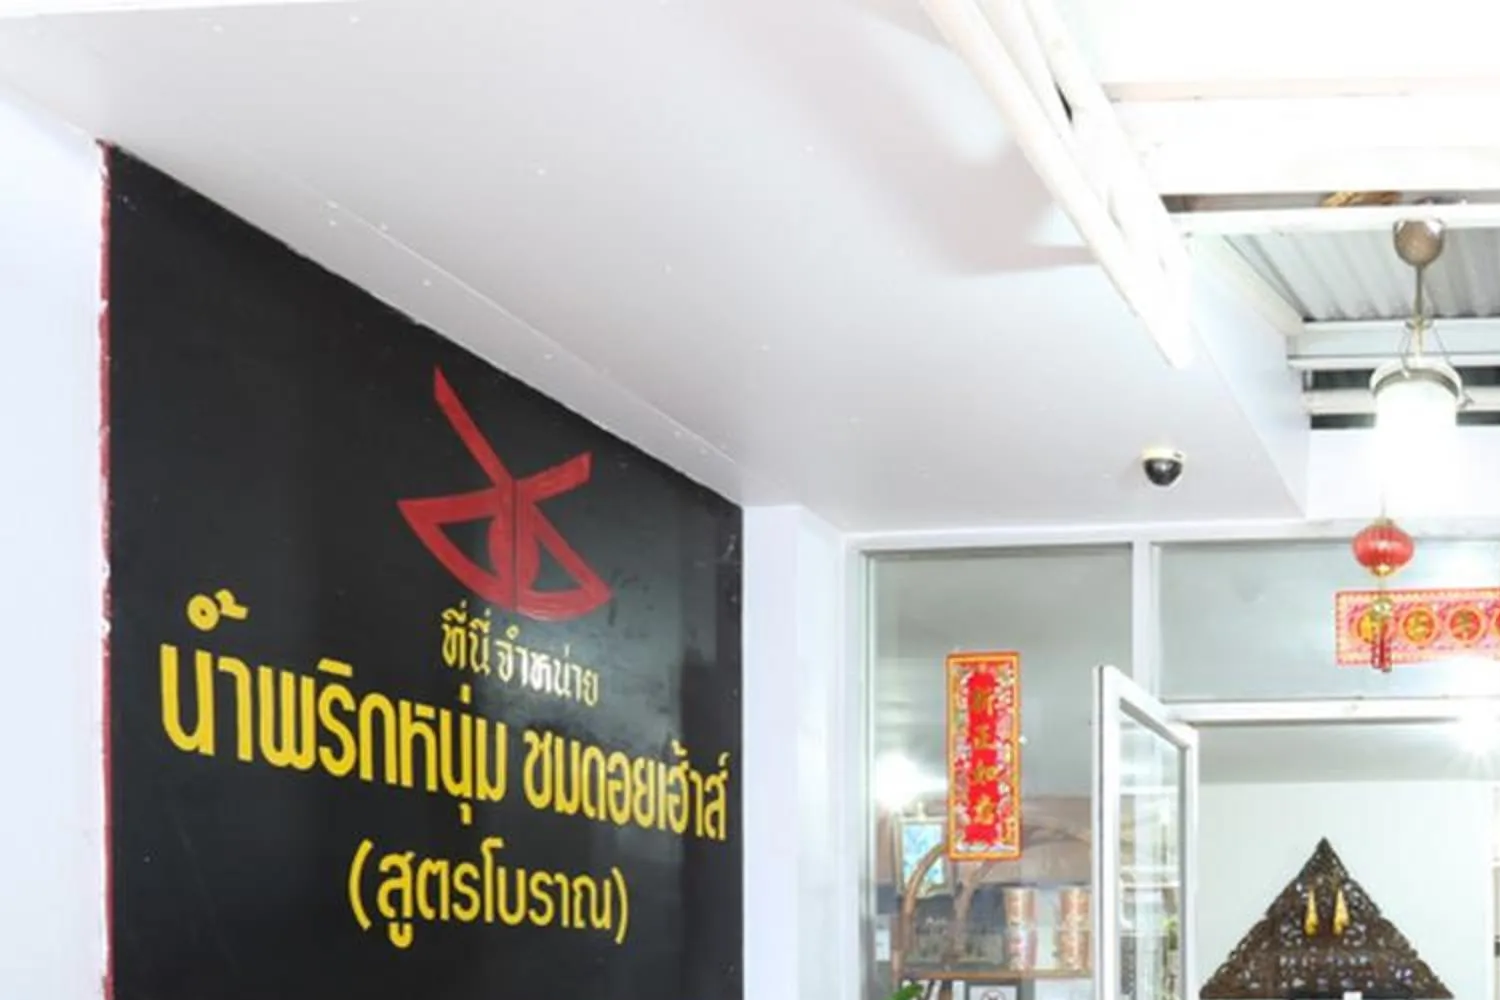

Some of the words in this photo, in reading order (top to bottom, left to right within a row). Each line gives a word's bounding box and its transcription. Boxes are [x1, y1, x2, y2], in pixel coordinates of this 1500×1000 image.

[160, 588, 508, 825] น้ำพริกหนุ่ม
[441, 600, 491, 676] ที่นี่
[495, 624, 599, 707] จำหน่าย
[348, 837, 629, 948] (สูตรโบราณ)
